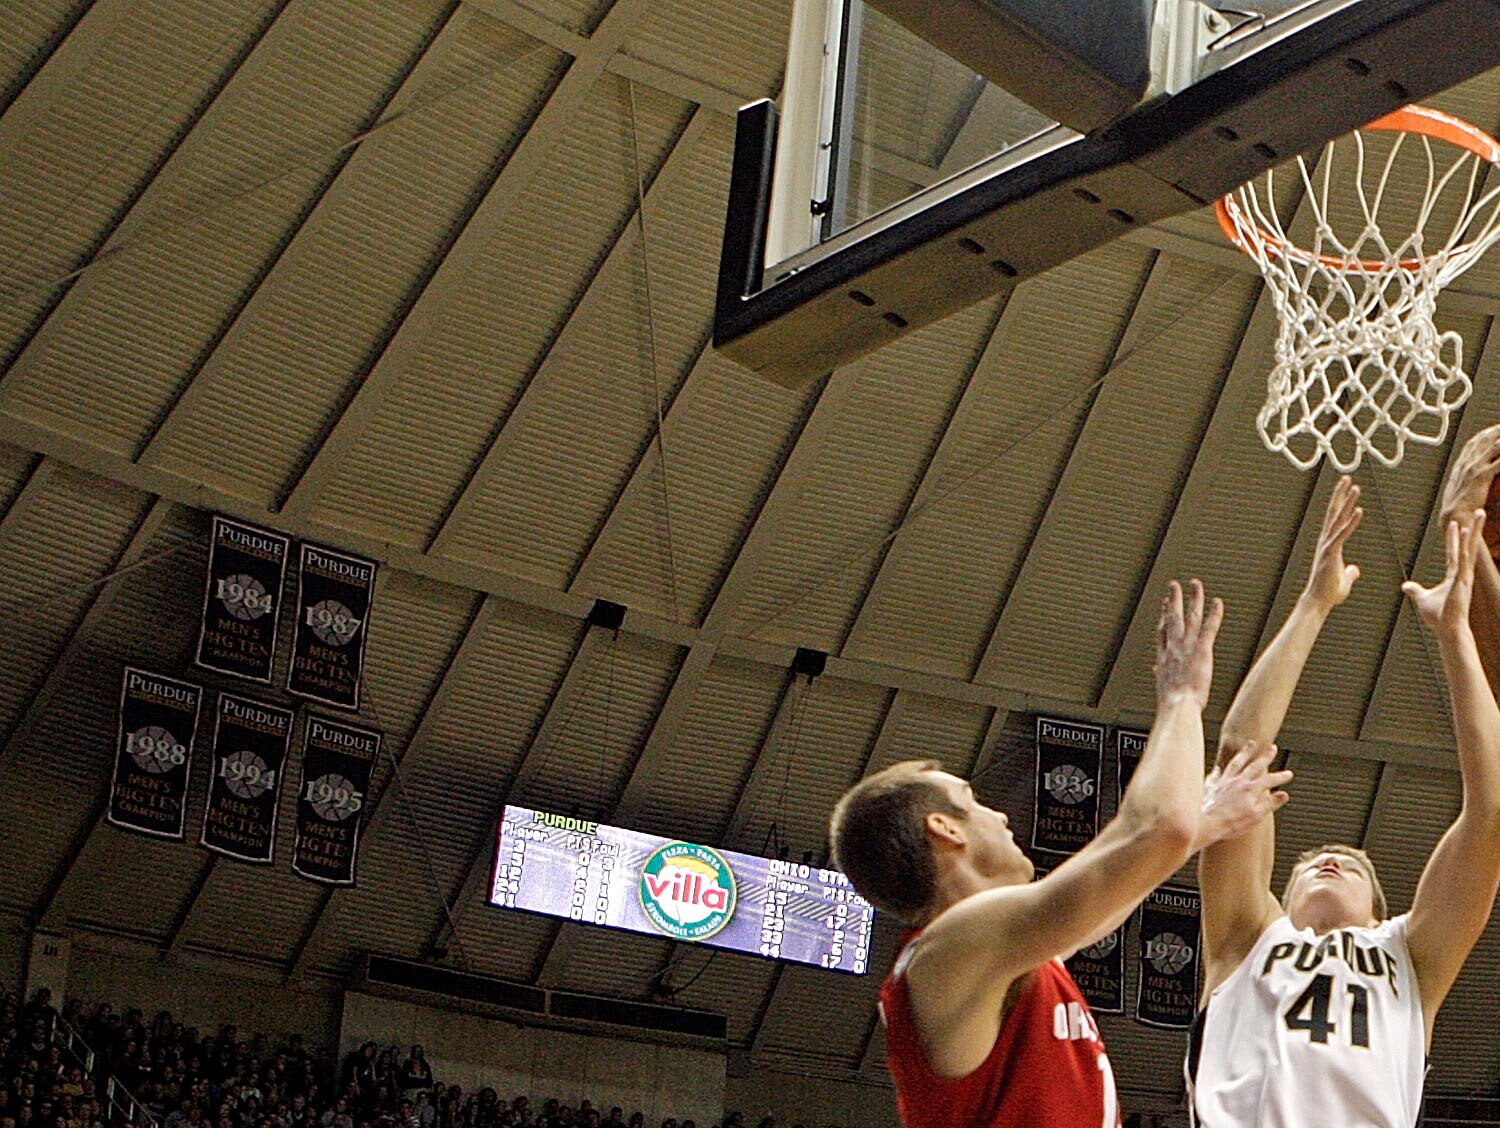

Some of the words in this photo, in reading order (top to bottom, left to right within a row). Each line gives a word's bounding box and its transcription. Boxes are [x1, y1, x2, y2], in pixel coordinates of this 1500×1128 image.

[218, 523, 283, 556] PURDUE
[307, 552, 370, 582] PURDUE
[216, 578, 273, 614] 1984
[217, 617, 261, 639] MEN'S
[305, 606, 362, 638] 1987
[308, 644, 349, 665] MEN'S
[129, 673, 196, 706] PURDUE
[223, 699, 288, 728] PURDUE
[312, 722, 377, 753] PURDUE
[1041, 724, 1099, 745] PURDUE
[125, 732, 187, 766] 1988
[127, 773, 172, 794] MEN'S
[220, 756, 276, 791] 1994
[1043, 771, 1095, 797] 1936
[150, 790, 181, 812] TEN
[304, 781, 363, 812] 1995
[220, 797, 260, 819] MEN'S
[239, 815, 270, 837] TEN
[306, 821, 347, 841] MEN'S
[533, 811, 598, 836] PURDUE
[579, 852, 591, 867] 0
[769, 861, 811, 880] OHIO
[573, 893, 585, 907] 0
[597, 897, 609, 911] 0
[647, 873, 726, 910] villa
[571, 906, 583, 920] 0
[595, 911, 607, 925] 0
[837, 904, 848, 917] 0
[826, 916, 847, 930] 17
[1143, 940, 1194, 963] 1979
[821, 954, 842, 969] 17
[853, 960, 865, 974] 0
[1284, 972, 1370, 1049] 41
